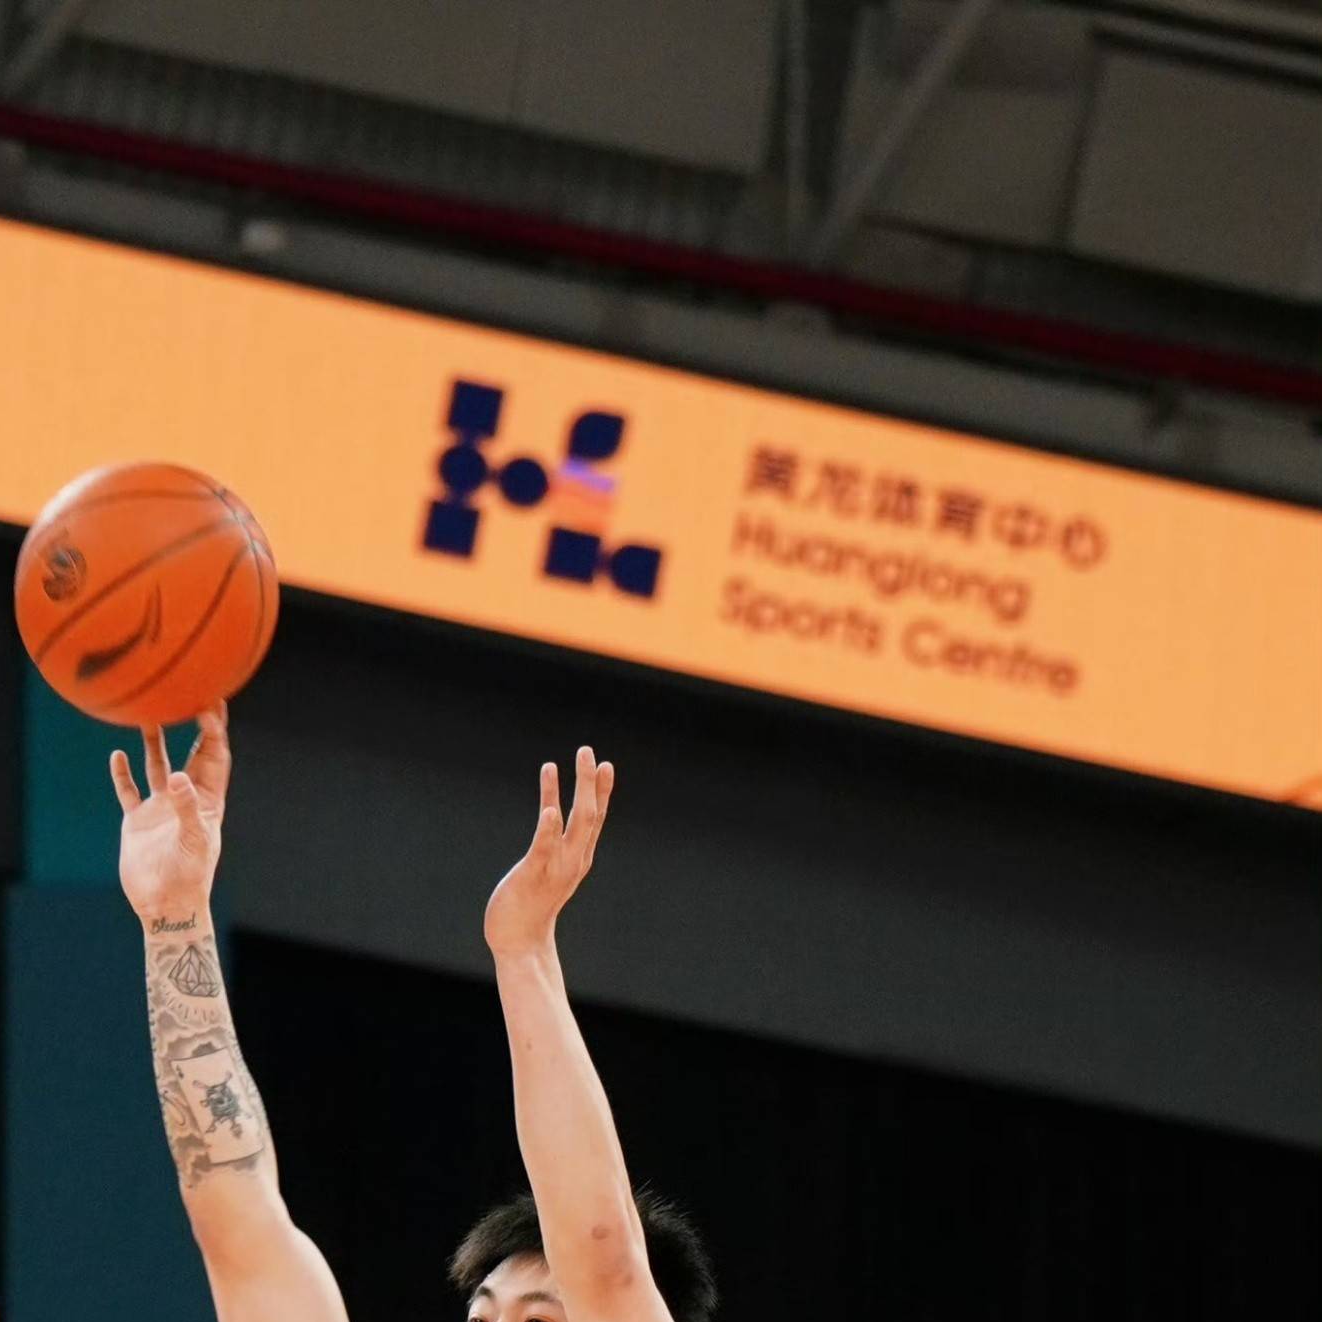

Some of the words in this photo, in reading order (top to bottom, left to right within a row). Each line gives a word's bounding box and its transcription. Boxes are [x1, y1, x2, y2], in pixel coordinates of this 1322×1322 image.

[730, 514, 1032, 624] Huanglong
[744, 444, 1108, 572] 黄龙体育中心
[719, 576, 883, 657] Sports
[902, 617, 1080, 698] Centre
